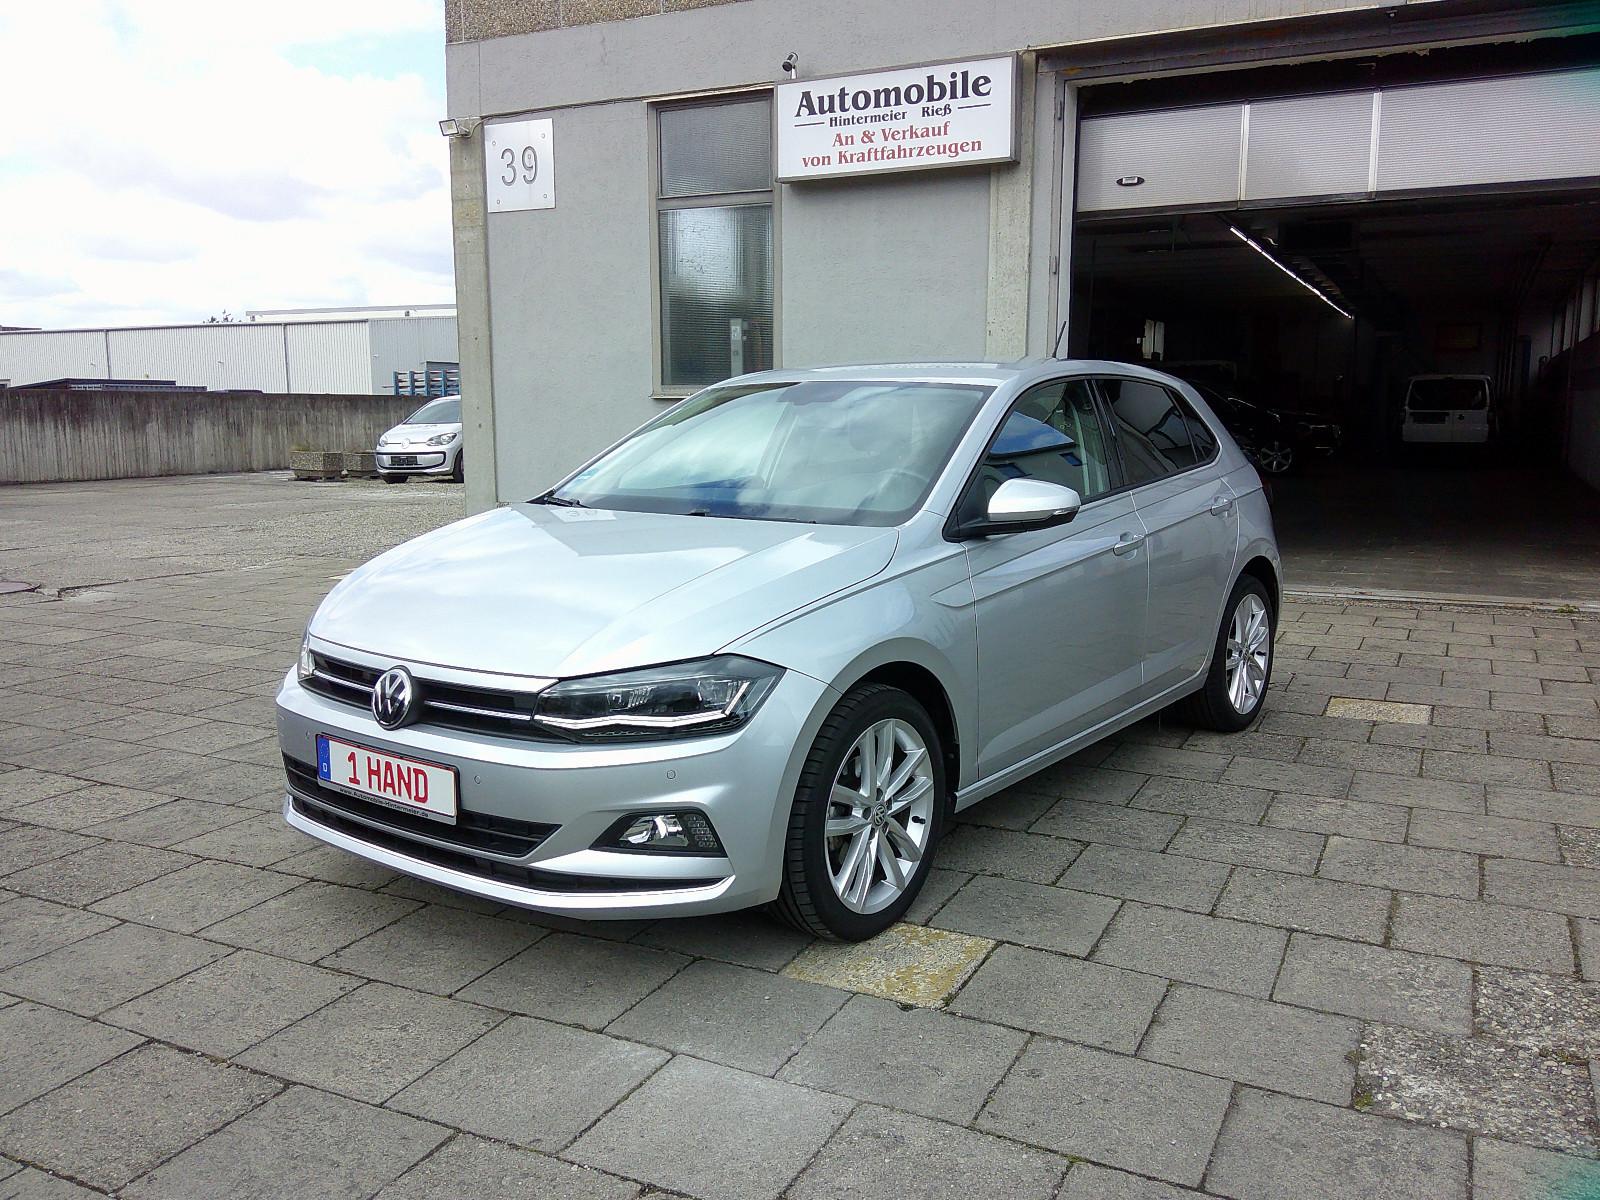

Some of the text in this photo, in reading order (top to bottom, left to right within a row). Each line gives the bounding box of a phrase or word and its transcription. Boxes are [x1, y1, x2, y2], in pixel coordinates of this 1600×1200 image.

[794, 70, 992, 117] Automobile
[829, 104, 952, 127] Hintermeier Rieß
[832, 121, 951, 147] An & Verkauf
[500, 145, 537, 186] 39
[801, 139, 982, 168] von Kraftfahrzeugen
[347, 751, 429, 804] 1 HAND
